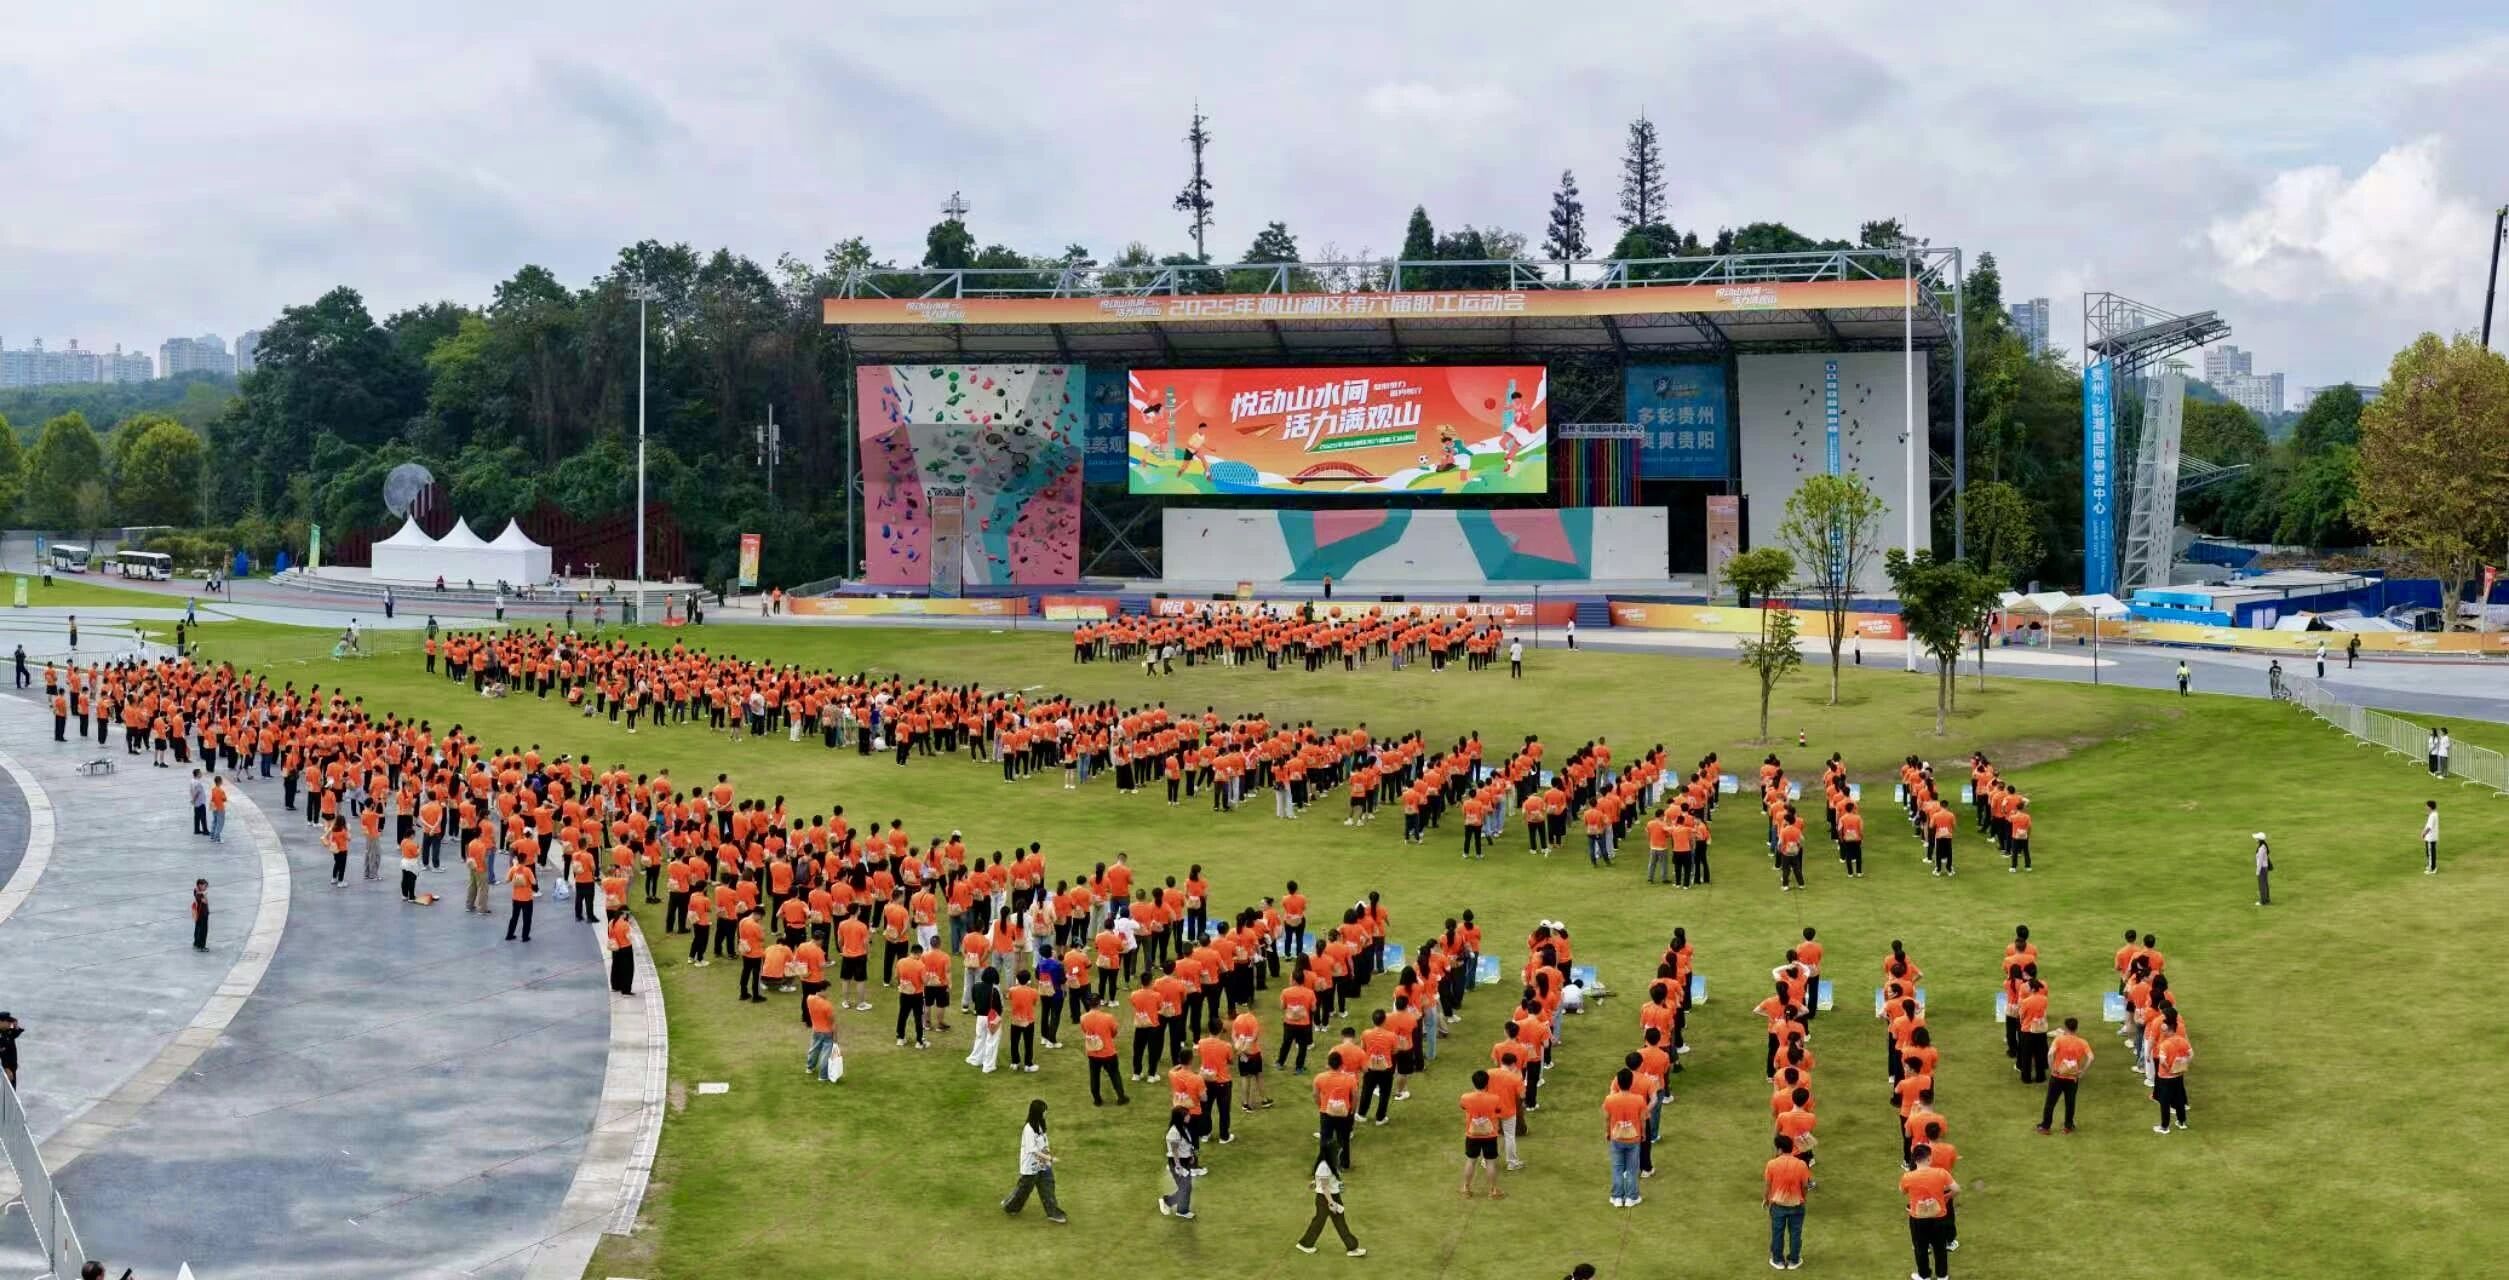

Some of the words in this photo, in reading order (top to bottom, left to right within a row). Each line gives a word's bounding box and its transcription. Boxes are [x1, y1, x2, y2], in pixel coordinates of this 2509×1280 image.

[1168, 293, 1526, 316] 2025年观山湖区第六届职工运动会
[1230, 379, 1369, 423] 悦动山水间
[1638, 406, 1714, 424] 多彩贵州
[1281, 401, 1421, 451] 活力满观山
